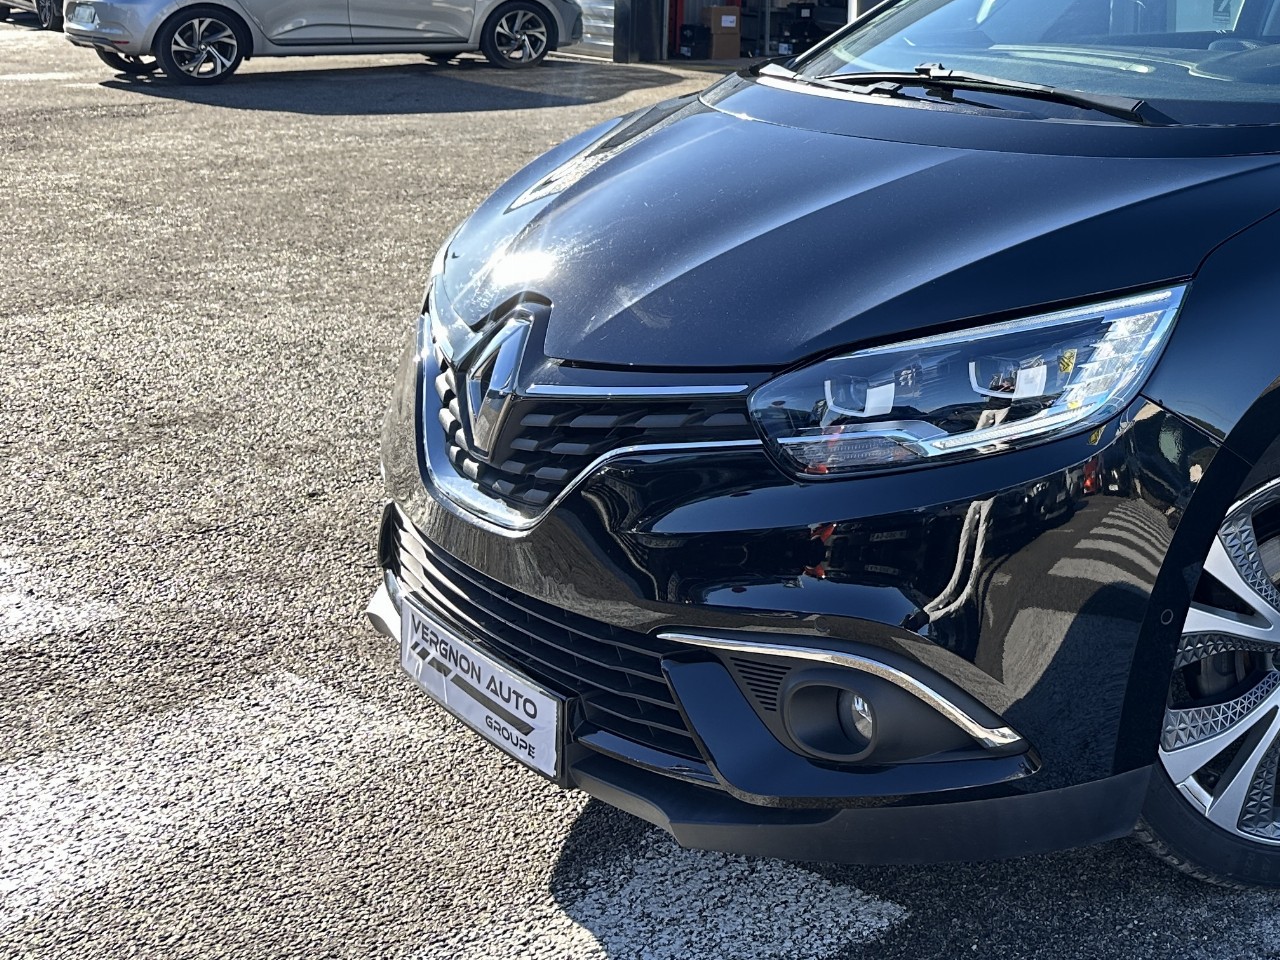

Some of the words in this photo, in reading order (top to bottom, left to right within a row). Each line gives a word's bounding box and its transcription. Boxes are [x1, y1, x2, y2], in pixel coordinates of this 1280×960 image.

[411, 613, 481, 684] VERGNON
[485, 675, 538, 719] AUTO
[485, 714, 536, 759] GROUPE
